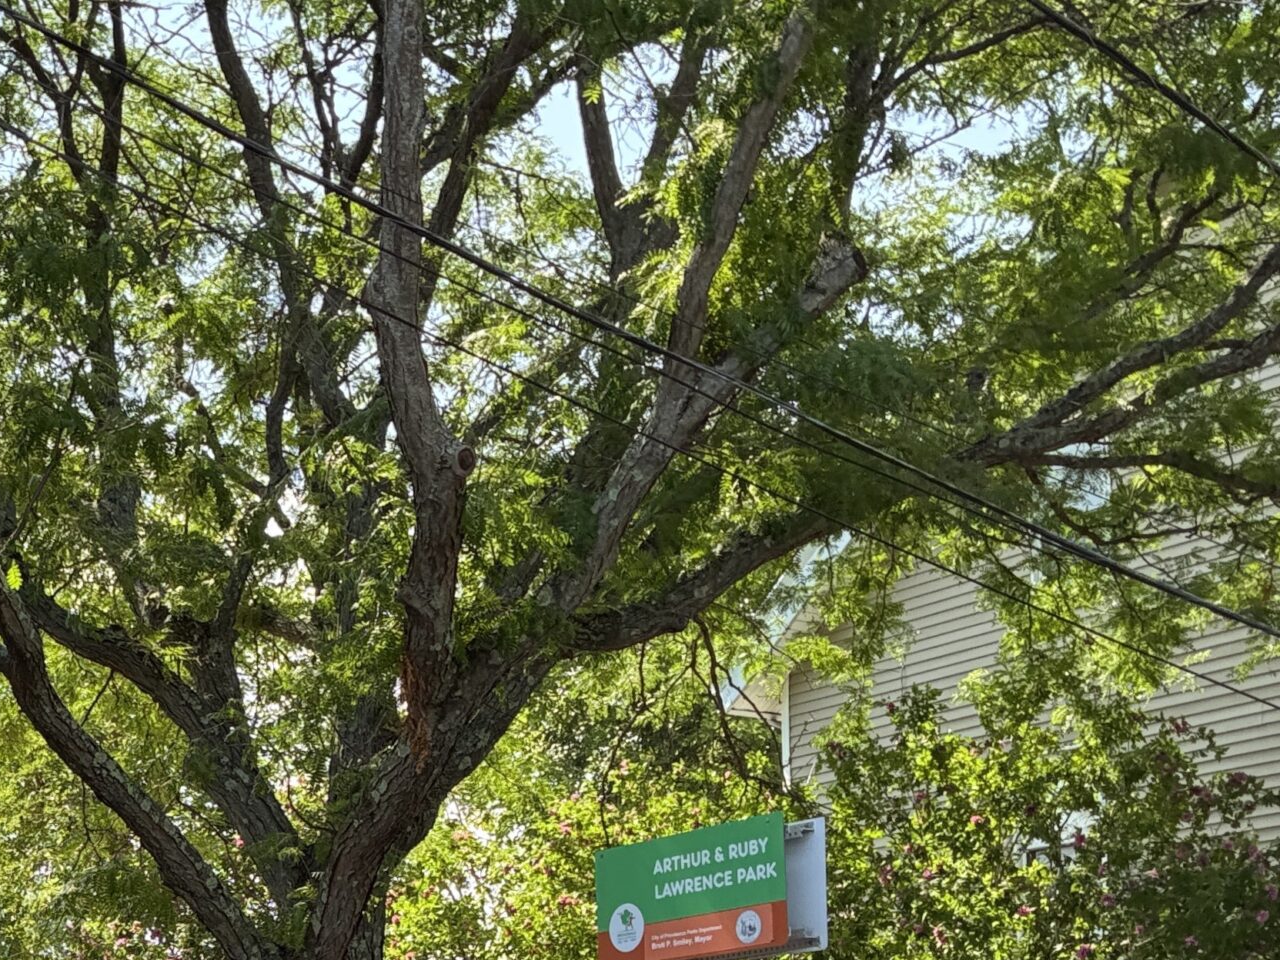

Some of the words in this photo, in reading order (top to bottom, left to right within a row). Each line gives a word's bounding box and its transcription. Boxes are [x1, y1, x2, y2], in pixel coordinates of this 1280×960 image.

[652, 849, 711, 876] ARTHUR
[714, 846, 725, 863] &
[728, 837, 769, 860] RUBY
[654, 870, 733, 899] LAWRENCE
[737, 862, 778, 884] PARK
